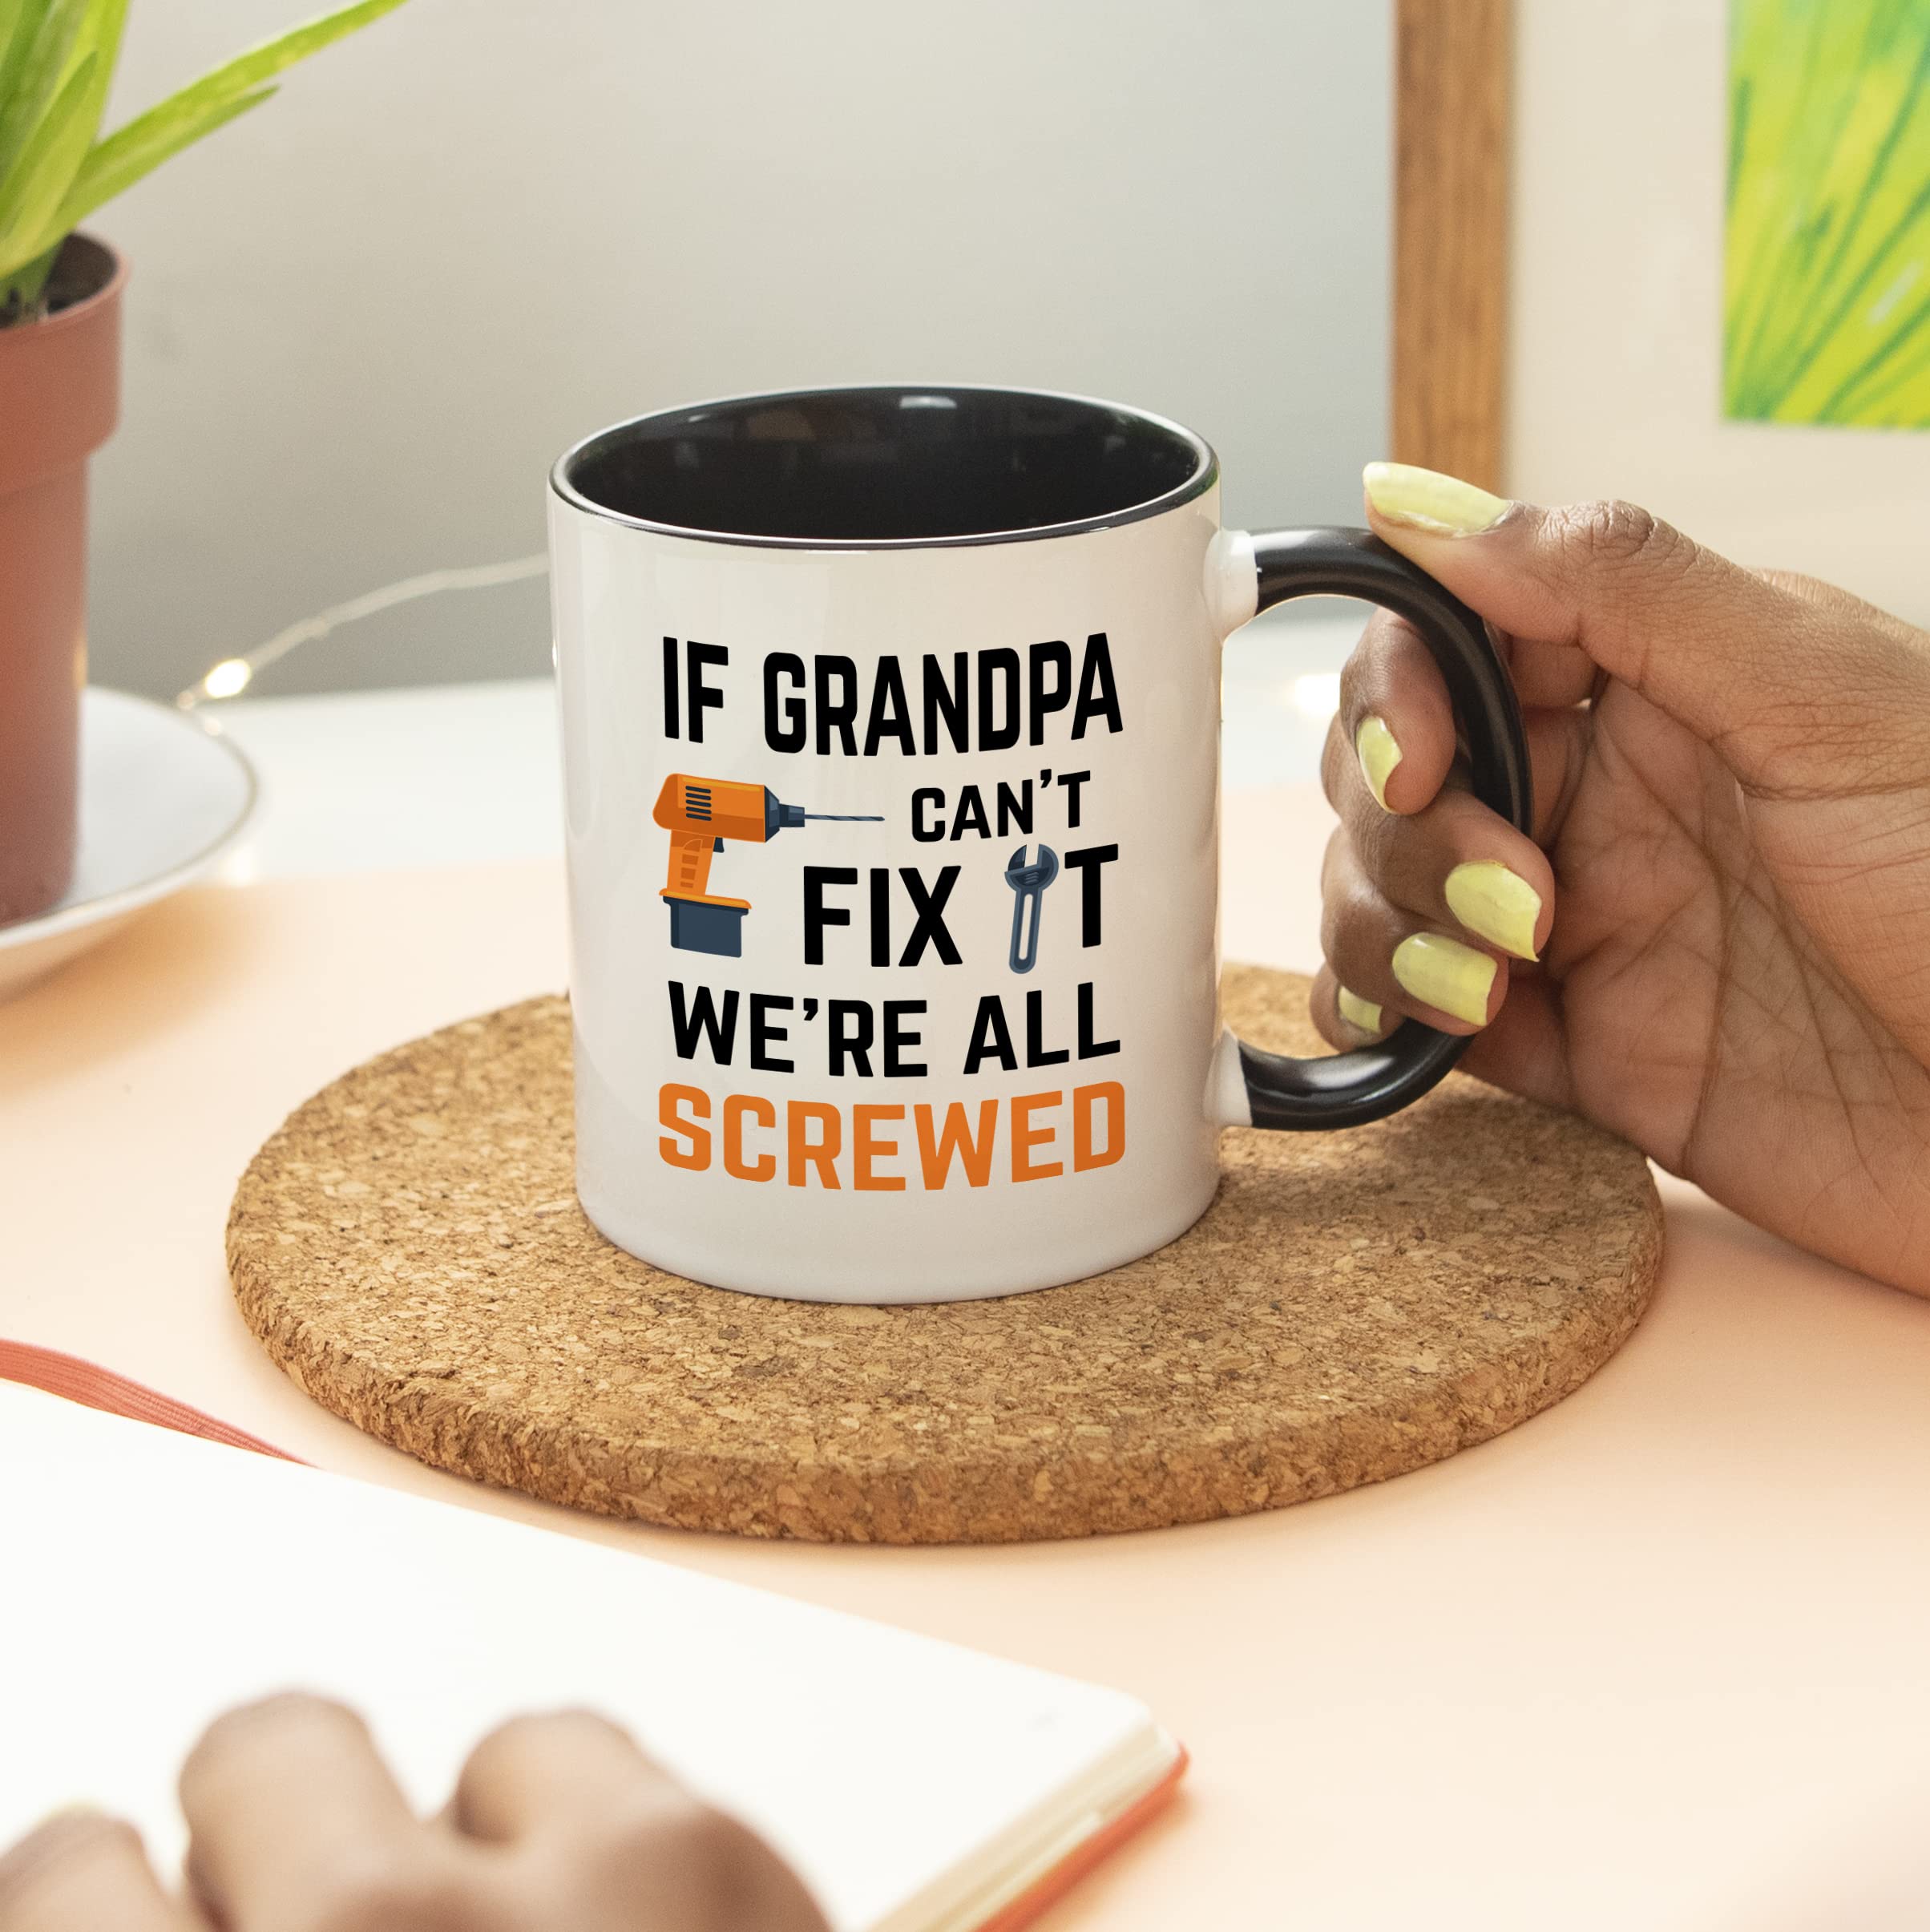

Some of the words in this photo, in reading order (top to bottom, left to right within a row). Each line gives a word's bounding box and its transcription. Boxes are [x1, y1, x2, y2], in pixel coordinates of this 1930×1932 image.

[662, 636, 729, 744] IF
[762, 632, 1124, 757] GRANDPA
[910, 768, 1091, 843] CAN'T
[802, 865, 963, 968] FIX
[668, 980, 928, 1078] WE'RE
[963, 981, 1120, 1075] ALL
[658, 1081, 1126, 1192] SCREWED
